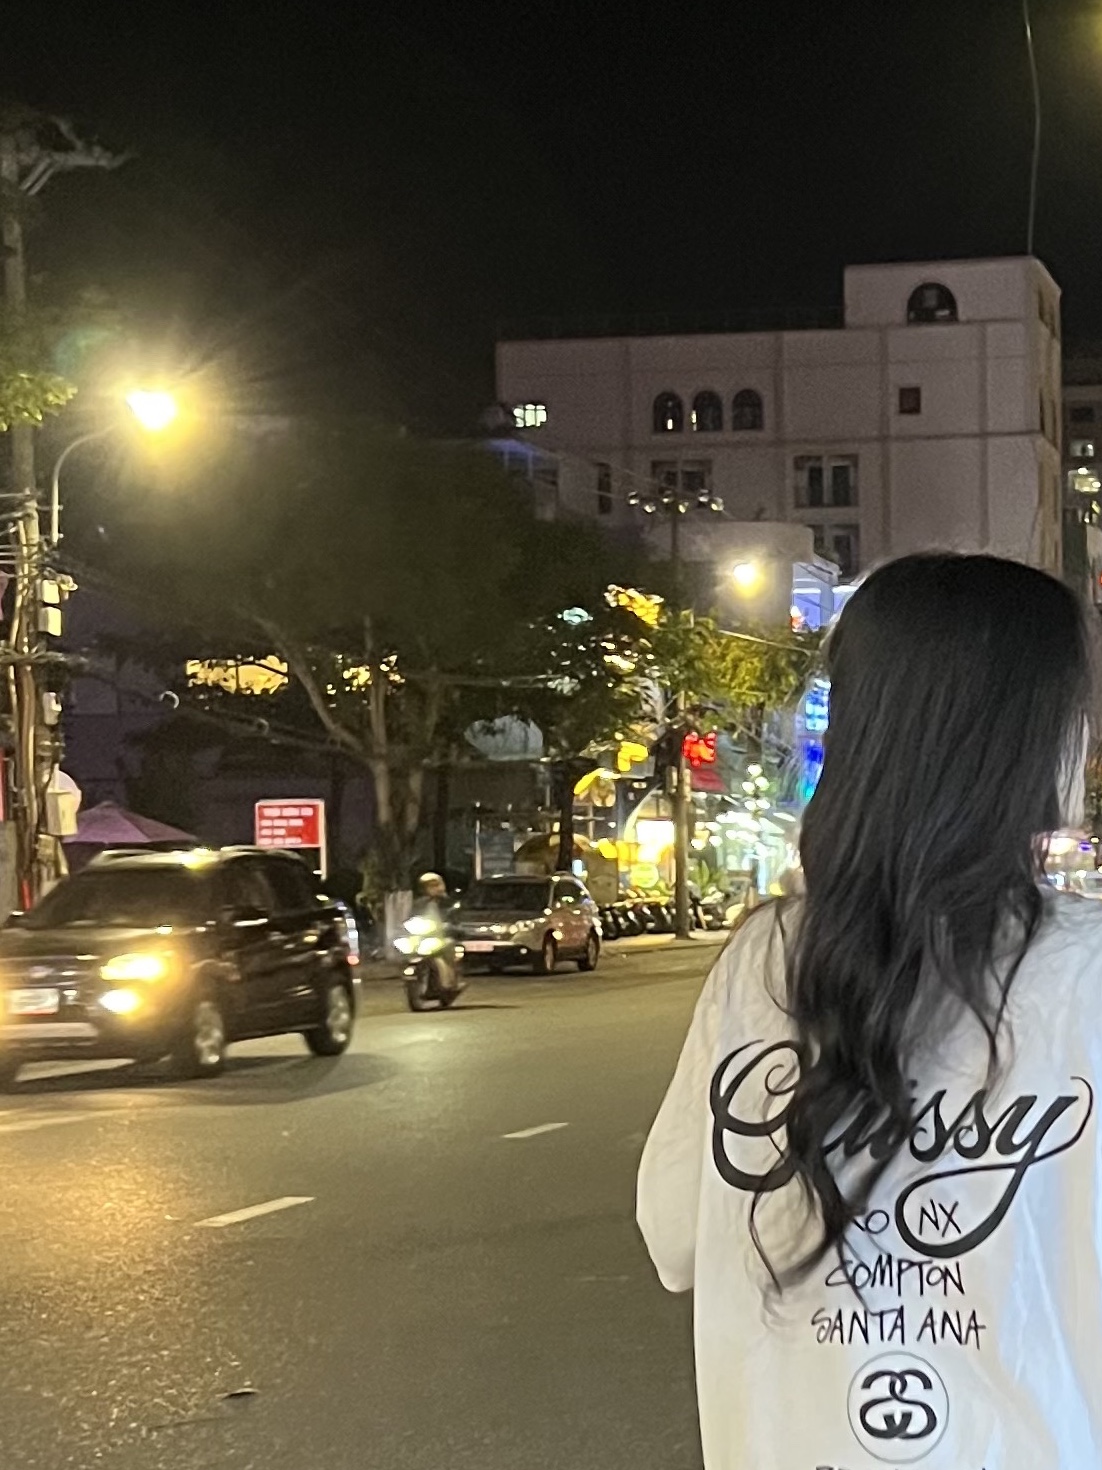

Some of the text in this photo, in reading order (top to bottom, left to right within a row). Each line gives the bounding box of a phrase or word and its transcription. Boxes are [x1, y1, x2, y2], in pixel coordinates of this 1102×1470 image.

[825, 1252, 967, 1297] COMPTON
[811, 1305, 987, 1351] SANTA ANA
